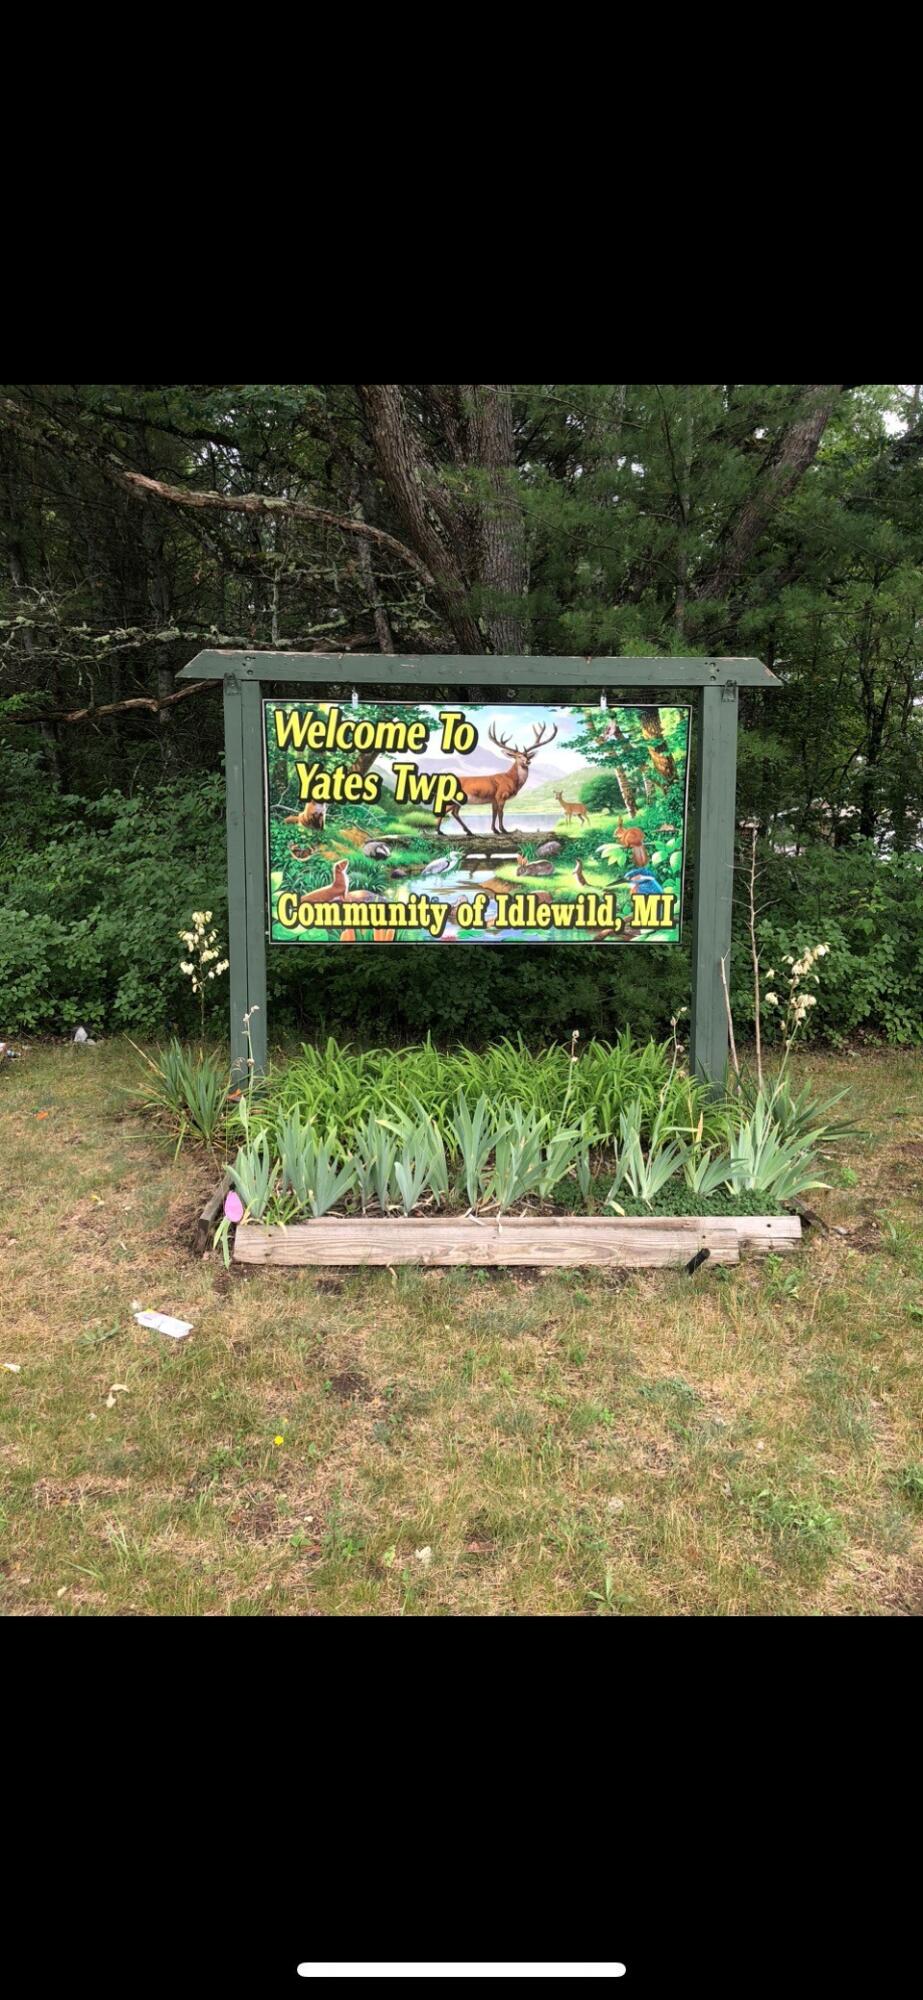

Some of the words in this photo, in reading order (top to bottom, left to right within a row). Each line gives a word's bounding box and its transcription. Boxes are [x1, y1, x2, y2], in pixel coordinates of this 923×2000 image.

[274, 707, 426, 751] Welcome
[439, 712, 476, 751] To
[296, 762, 380, 802] Yates
[392, 763, 466, 814] Twp.
[277, 892, 448, 936] Community
[456, 894, 487, 928] of
[494, 894, 622, 931] Idlewild,
[630, 894, 674, 928] MI
